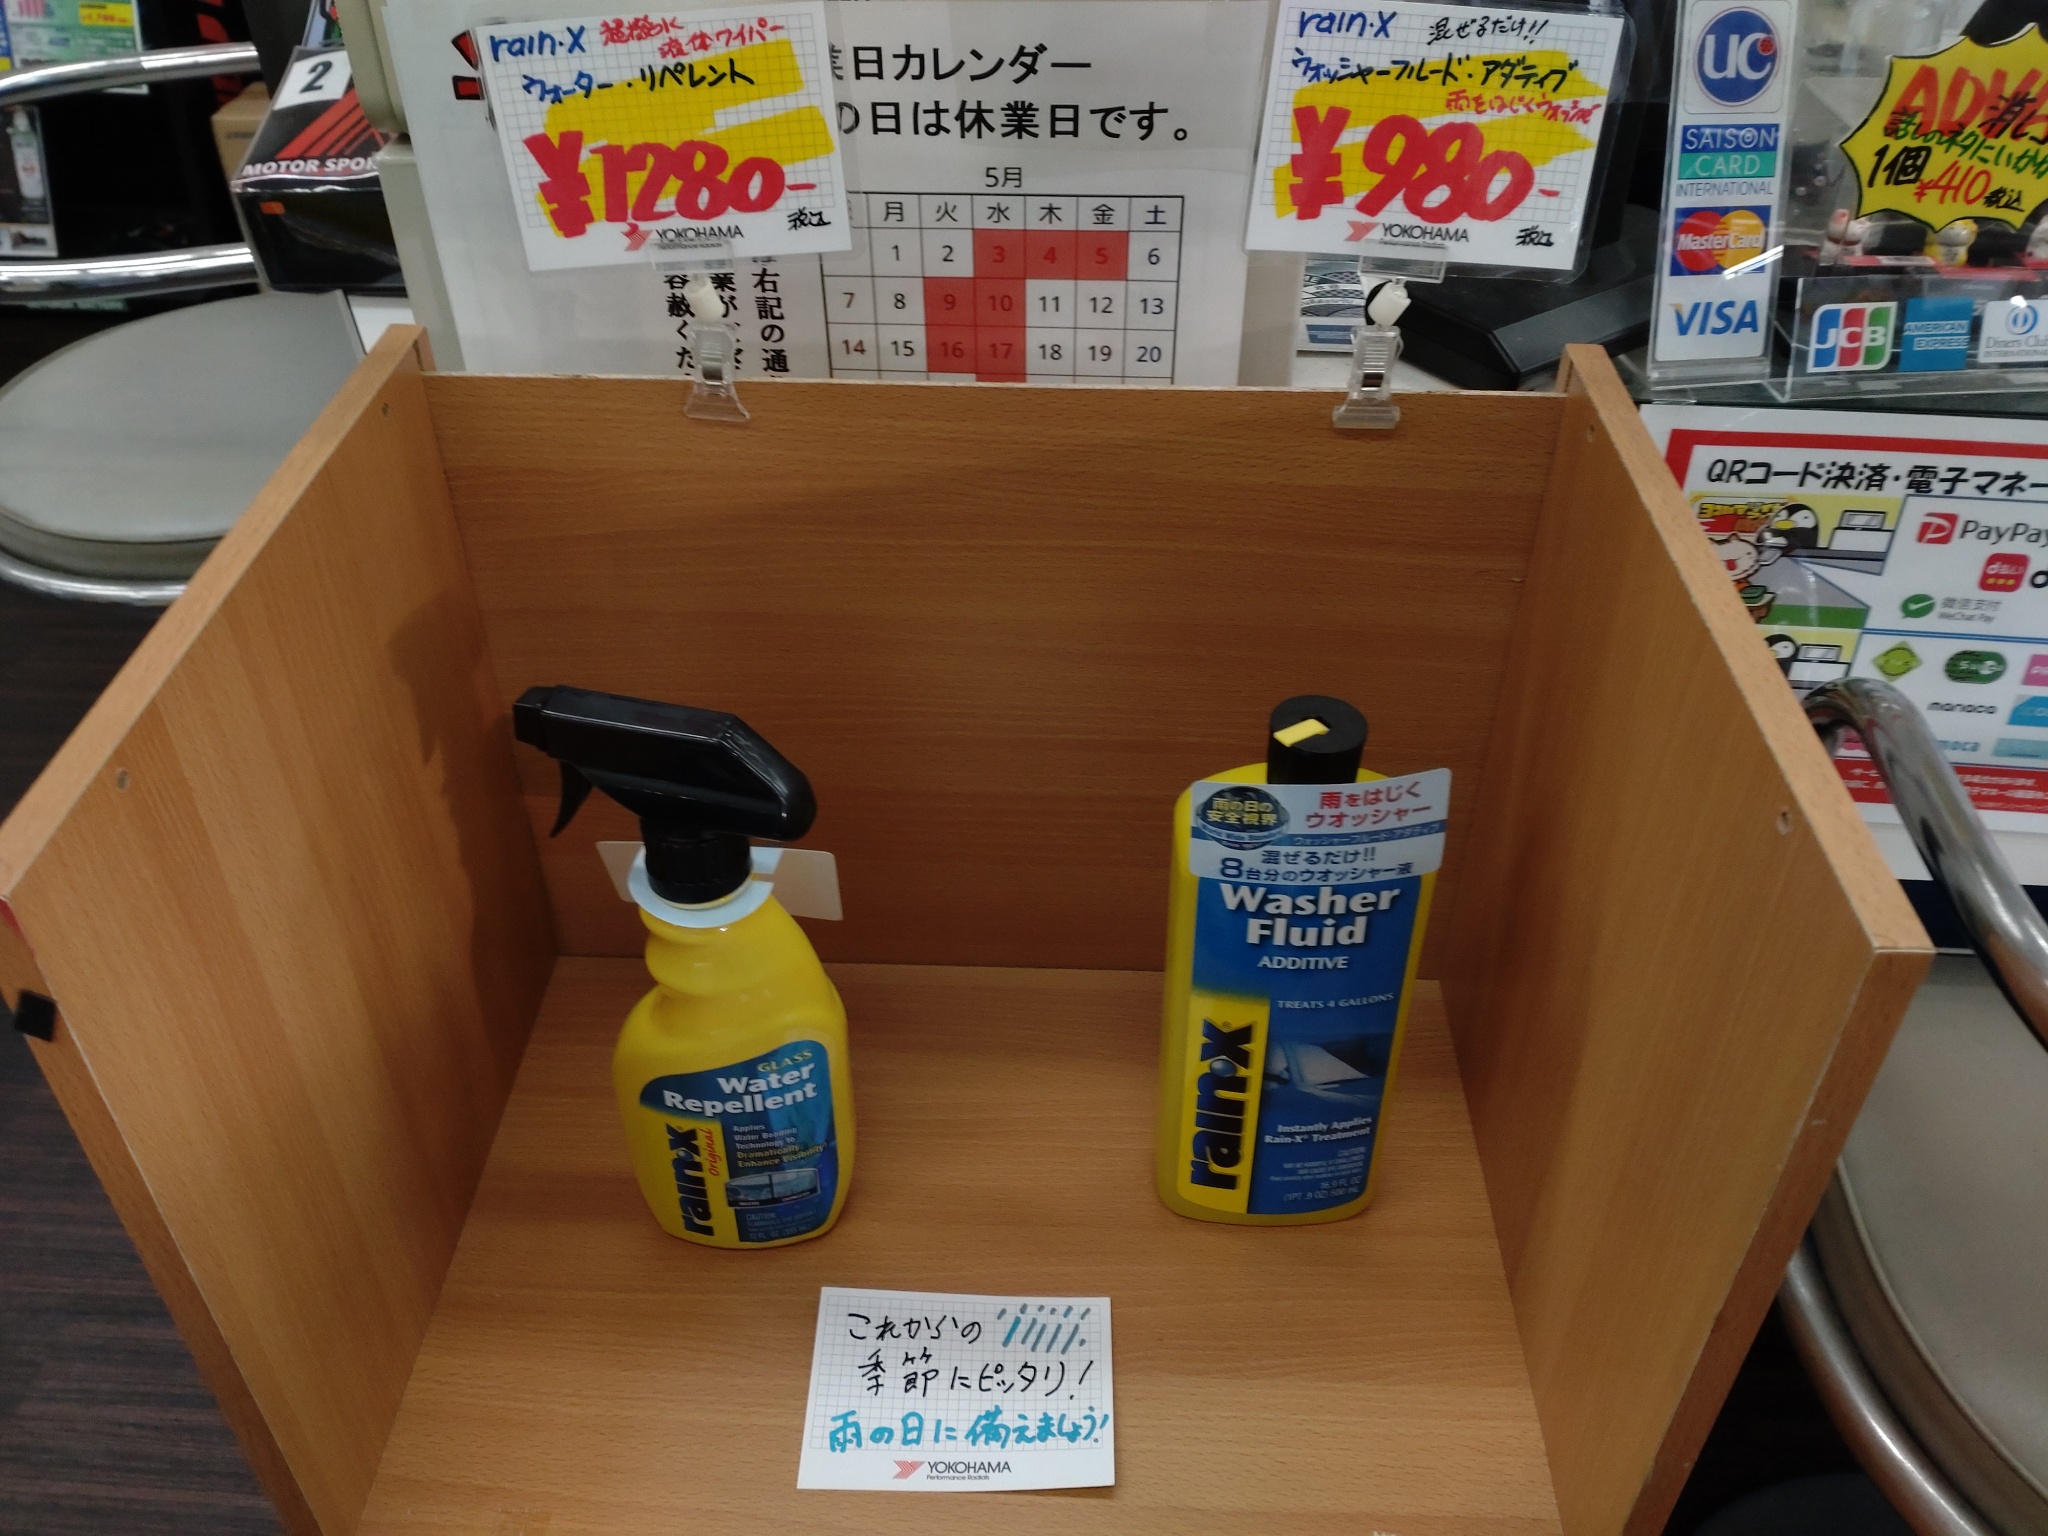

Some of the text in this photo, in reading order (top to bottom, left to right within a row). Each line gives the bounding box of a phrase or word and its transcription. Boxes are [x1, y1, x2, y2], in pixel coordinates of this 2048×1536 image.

[300, 61, 332, 93] 2
[1685, 125, 1776, 149] SAISON
[242, 160, 319, 178] MOTOR
[1694, 154, 1761, 177] CARD
[1868, 144, 1932, 188] 1個
[984, 167, 1023, 188] 5月
[1914, 160, 1992, 205] ¥410
[1676, 181, 1774, 197] INTERNATIONAL
[884, 201, 1167, 225] 月 火 水 木 金 土
[655, 224, 745, 243] YOKOHAMA
[1382, 222, 1470, 243] YOKOHAMA
[1676, 232, 1764, 252] MasterCard
[891, 245, 1160, 267] 1 2 3 4 5 6
[843, 292, 1165, 316] 7 8 9 10 11 12 13
[1670, 300, 1759, 336] VISA
[1904, 321, 1968, 335] AMERICAN
[1814, 325, 1886, 348] JCB
[1913, 337, 1968, 350] EXPRESS
[842, 339, 1162, 364] 14 15 16 17 18 19 20
[1212, 797, 1274, 812] 雨の日の
[1319, 781, 1423, 810] 雨をはじく
[1206, 810, 1278, 826] 安全視界
[1219, 883, 1401, 916] Washer
[1246, 915, 1368, 947] Fluid
[1257, 956, 1350, 970] ADDITIVE
[1277, 992, 1395, 1010] TREATS 4 GALLONS
[757, 1049, 813, 1073] GLASS
[717, 1063, 815, 1095] Water
[662, 1082, 818, 1118] Repellent
[1277, 1116, 1373, 1133] Instantly Applies
[1311, 1126, 1371, 1142] Treatment
[735, 1140, 784, 1151] Technology
[737, 1144, 801, 1159] Dramatically
[738, 1158, 780, 1168] Enhance
[848, 1313, 982, 1344] これからの
[927, 1460, 1012, 1474] YOKOHAMA
